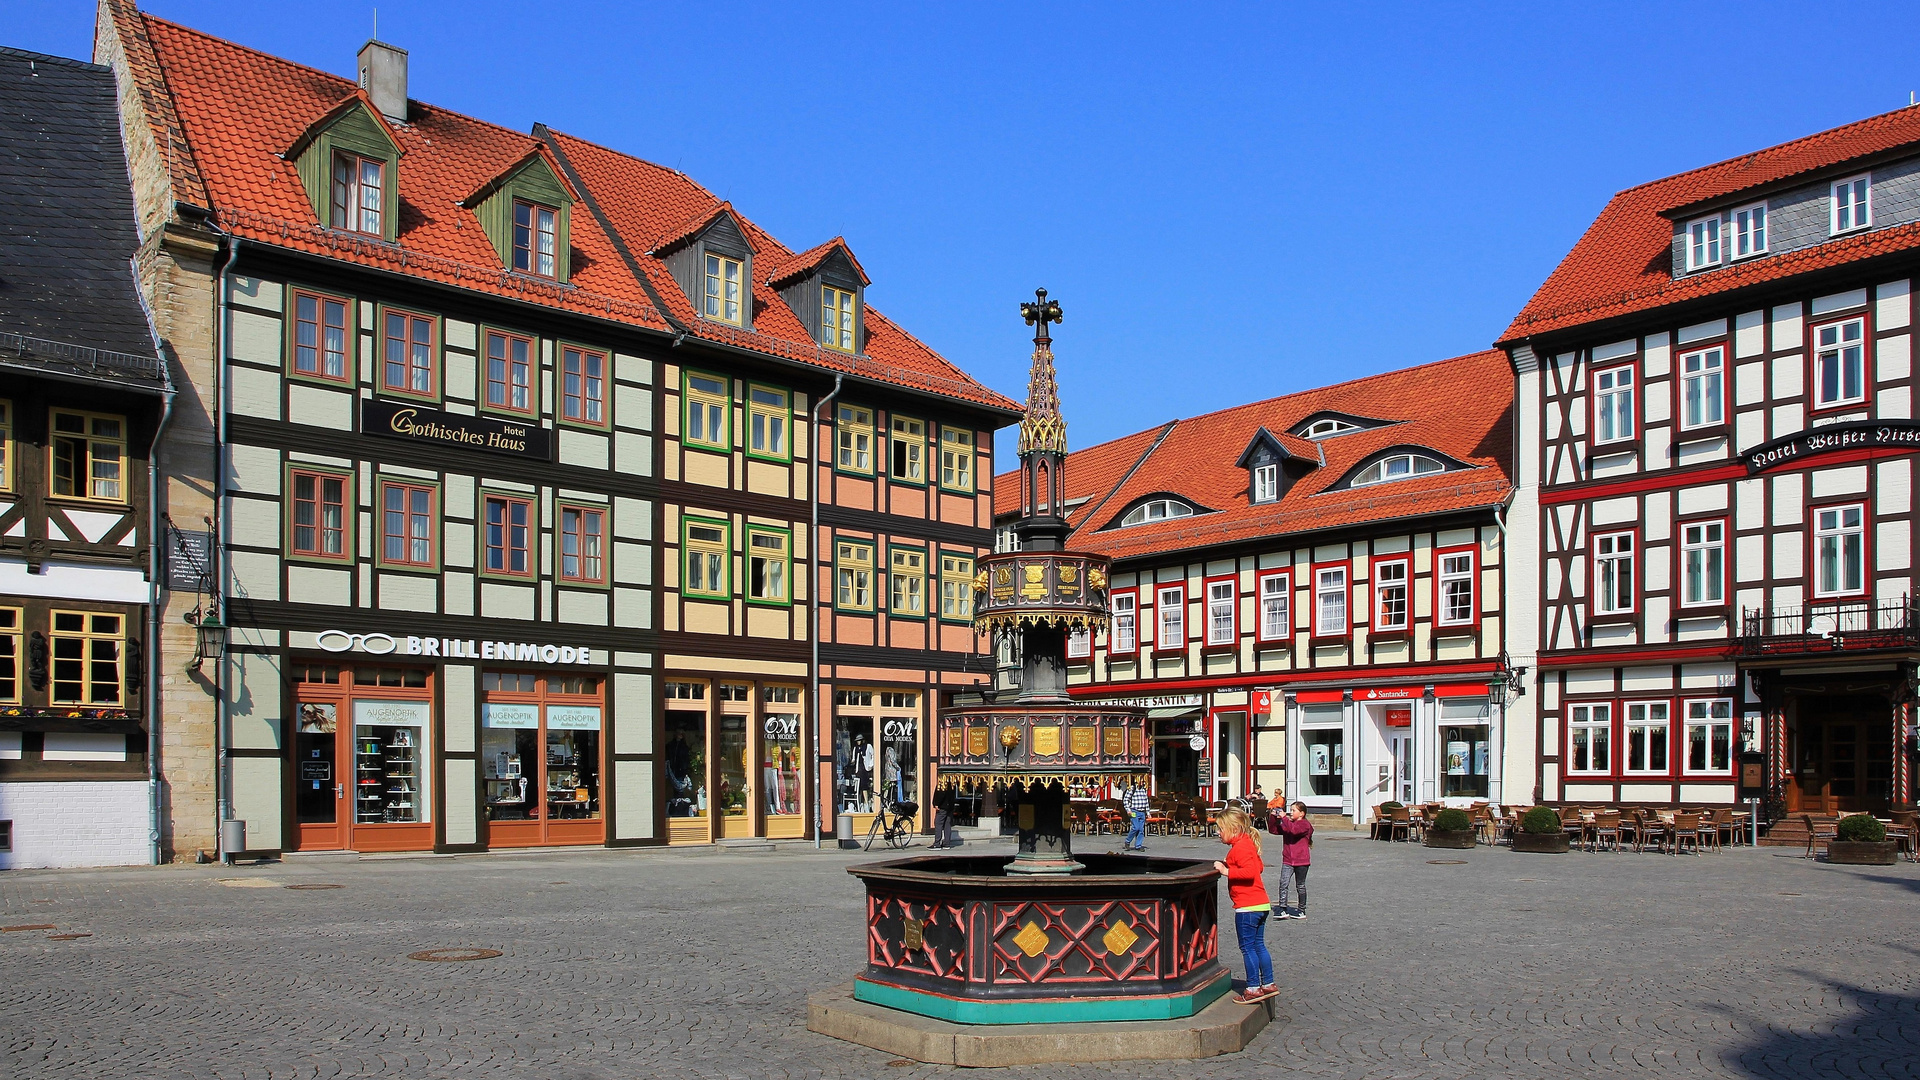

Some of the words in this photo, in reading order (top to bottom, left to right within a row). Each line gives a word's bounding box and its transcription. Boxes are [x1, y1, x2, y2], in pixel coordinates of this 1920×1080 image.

[391, 408, 484, 445] Gothisches
[487, 431, 526, 451] Haus
[504, 425, 525, 437] Hotel
[1752, 441, 1797, 468] Hotel
[1807, 430, 1867, 451] Weißer
[407, 635, 591, 665] BRILLENMODE
[1378, 689, 1409, 698] Santander
[1152, 695, 1187, 706] SANTIN
[366, 708, 417, 717] AUGENOPTIK
[487, 712, 533, 720] AUGENOPTIK
[552, 714, 596, 722] AUGENOPTIK
